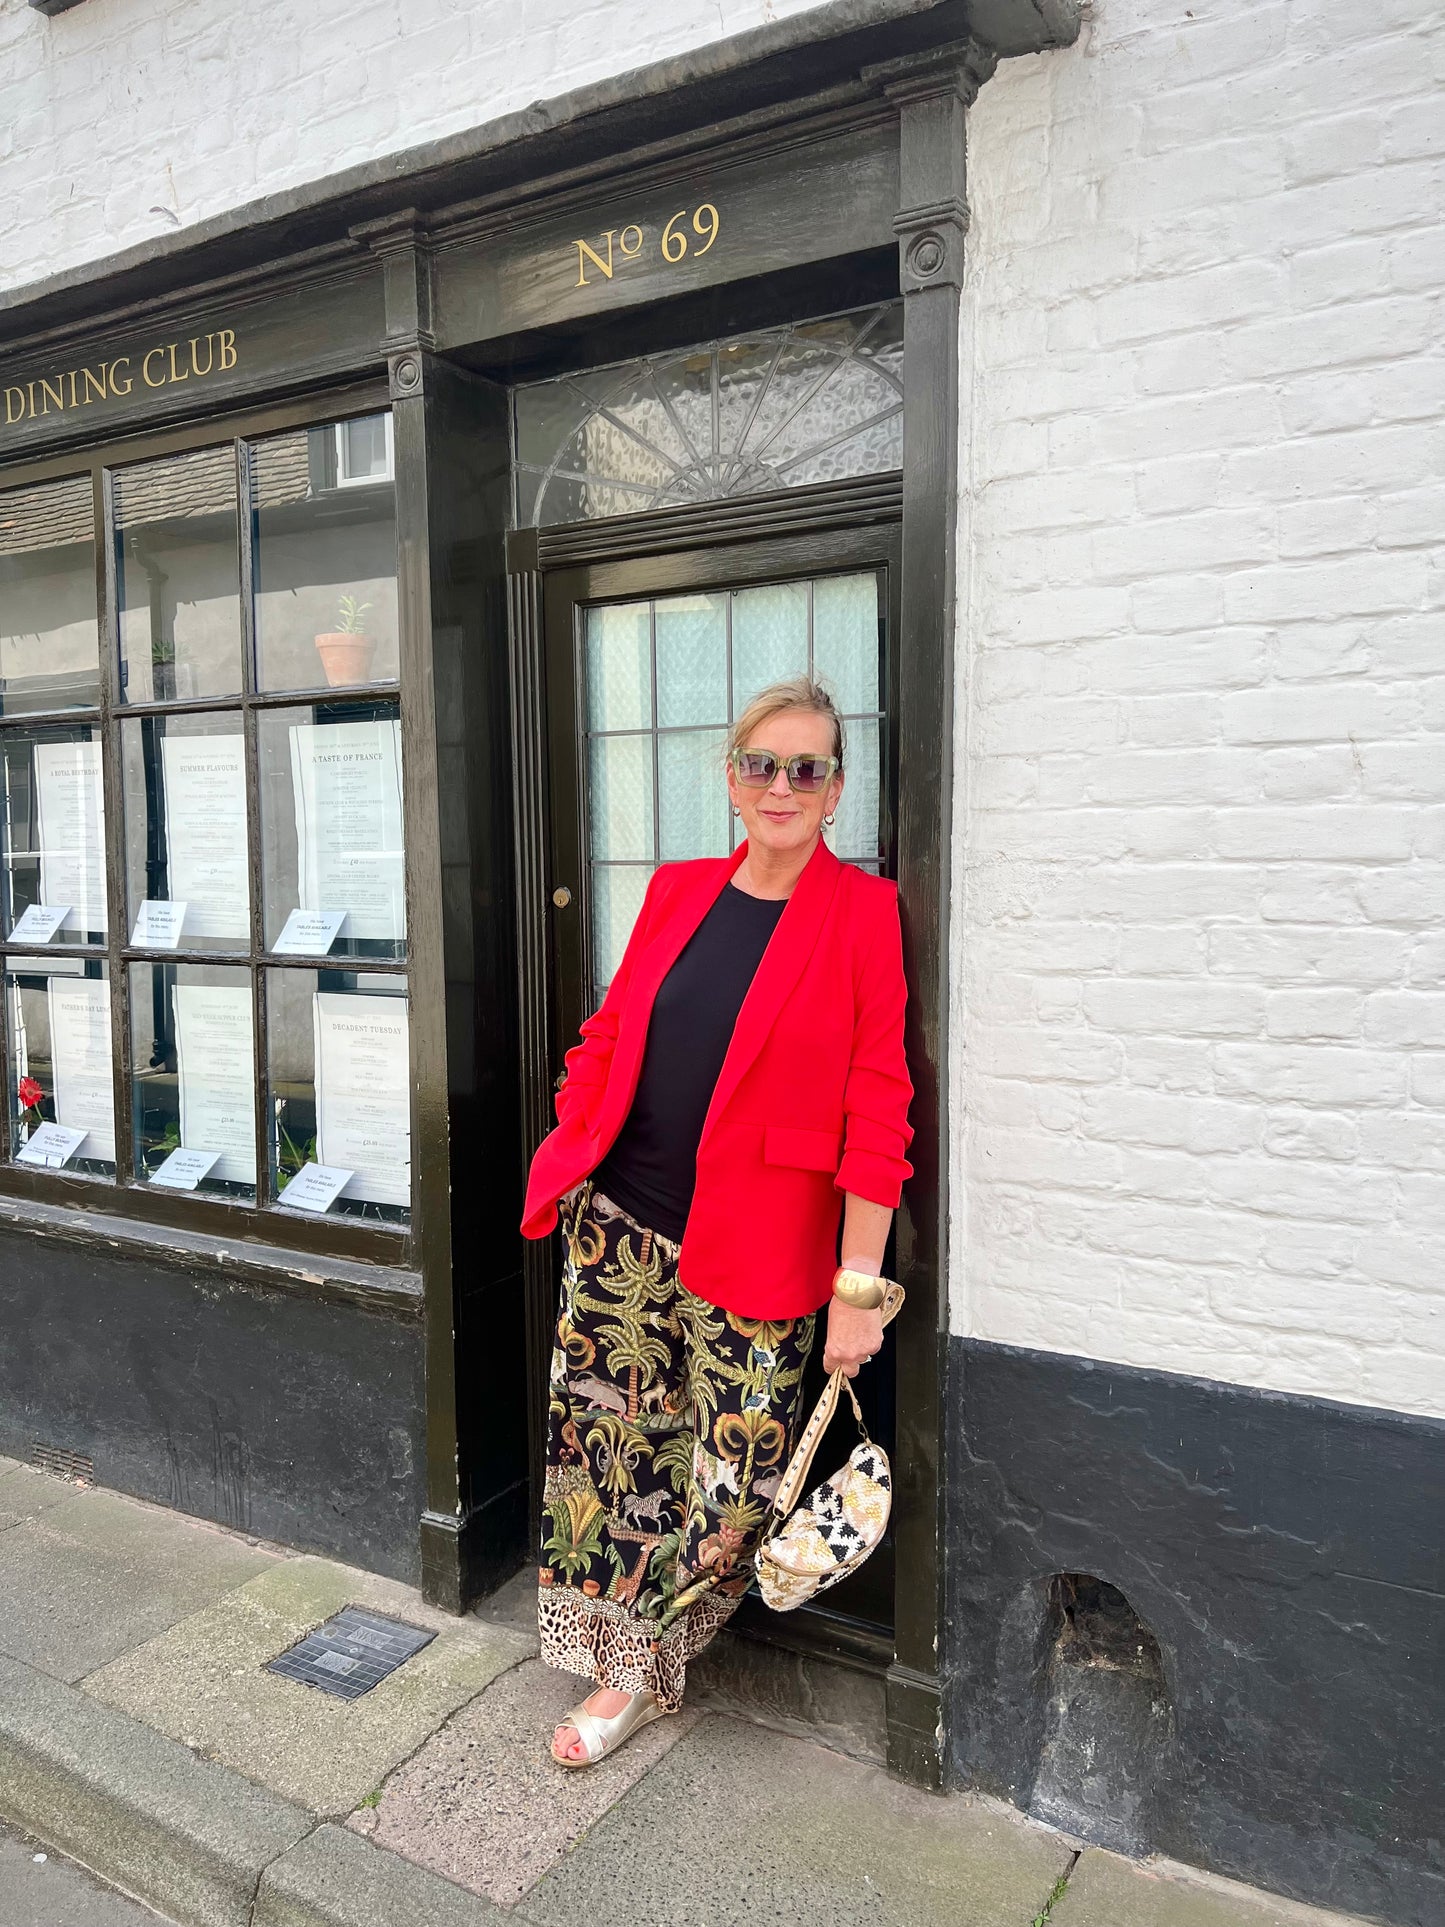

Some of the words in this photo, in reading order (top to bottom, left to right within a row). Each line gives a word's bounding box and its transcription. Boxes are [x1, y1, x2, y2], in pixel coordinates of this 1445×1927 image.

[661, 203, 720, 263] 69
[3, 357, 134, 425] DINING
[142, 329, 238, 388] CLUB
[318, 755, 341, 763] TASTE
[343, 754, 353, 762] OF
[355, 753, 383, 761] FRANCE
[180, 765, 205, 773] SUMMER
[206, 764, 238, 772] FLAVOURS
[332, 1023, 368, 1033] DECADENT
[370, 1026, 402, 1035] TUESDAY
